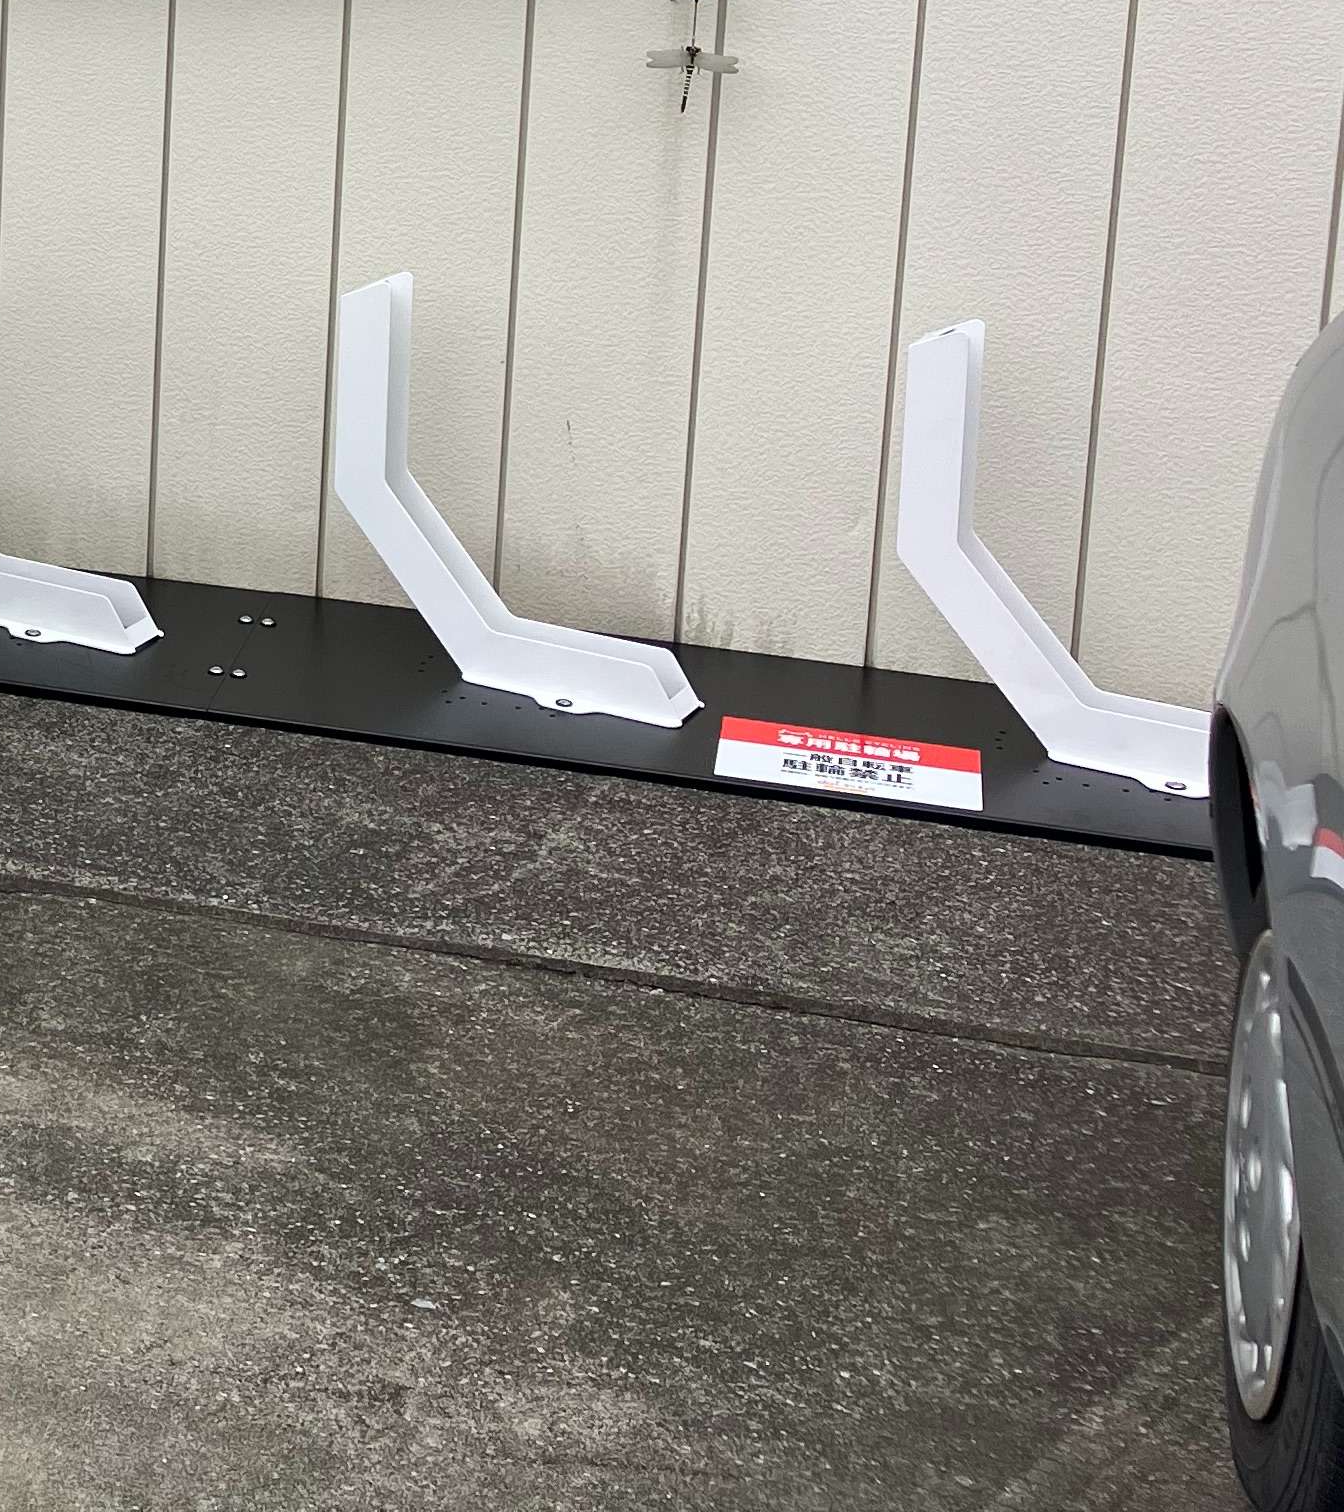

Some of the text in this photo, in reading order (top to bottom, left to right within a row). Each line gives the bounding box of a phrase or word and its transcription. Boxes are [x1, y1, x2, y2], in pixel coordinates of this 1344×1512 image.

[781, 758, 914, 785] 駐輪禁止
[782, 751, 914, 774] 一般自転車
